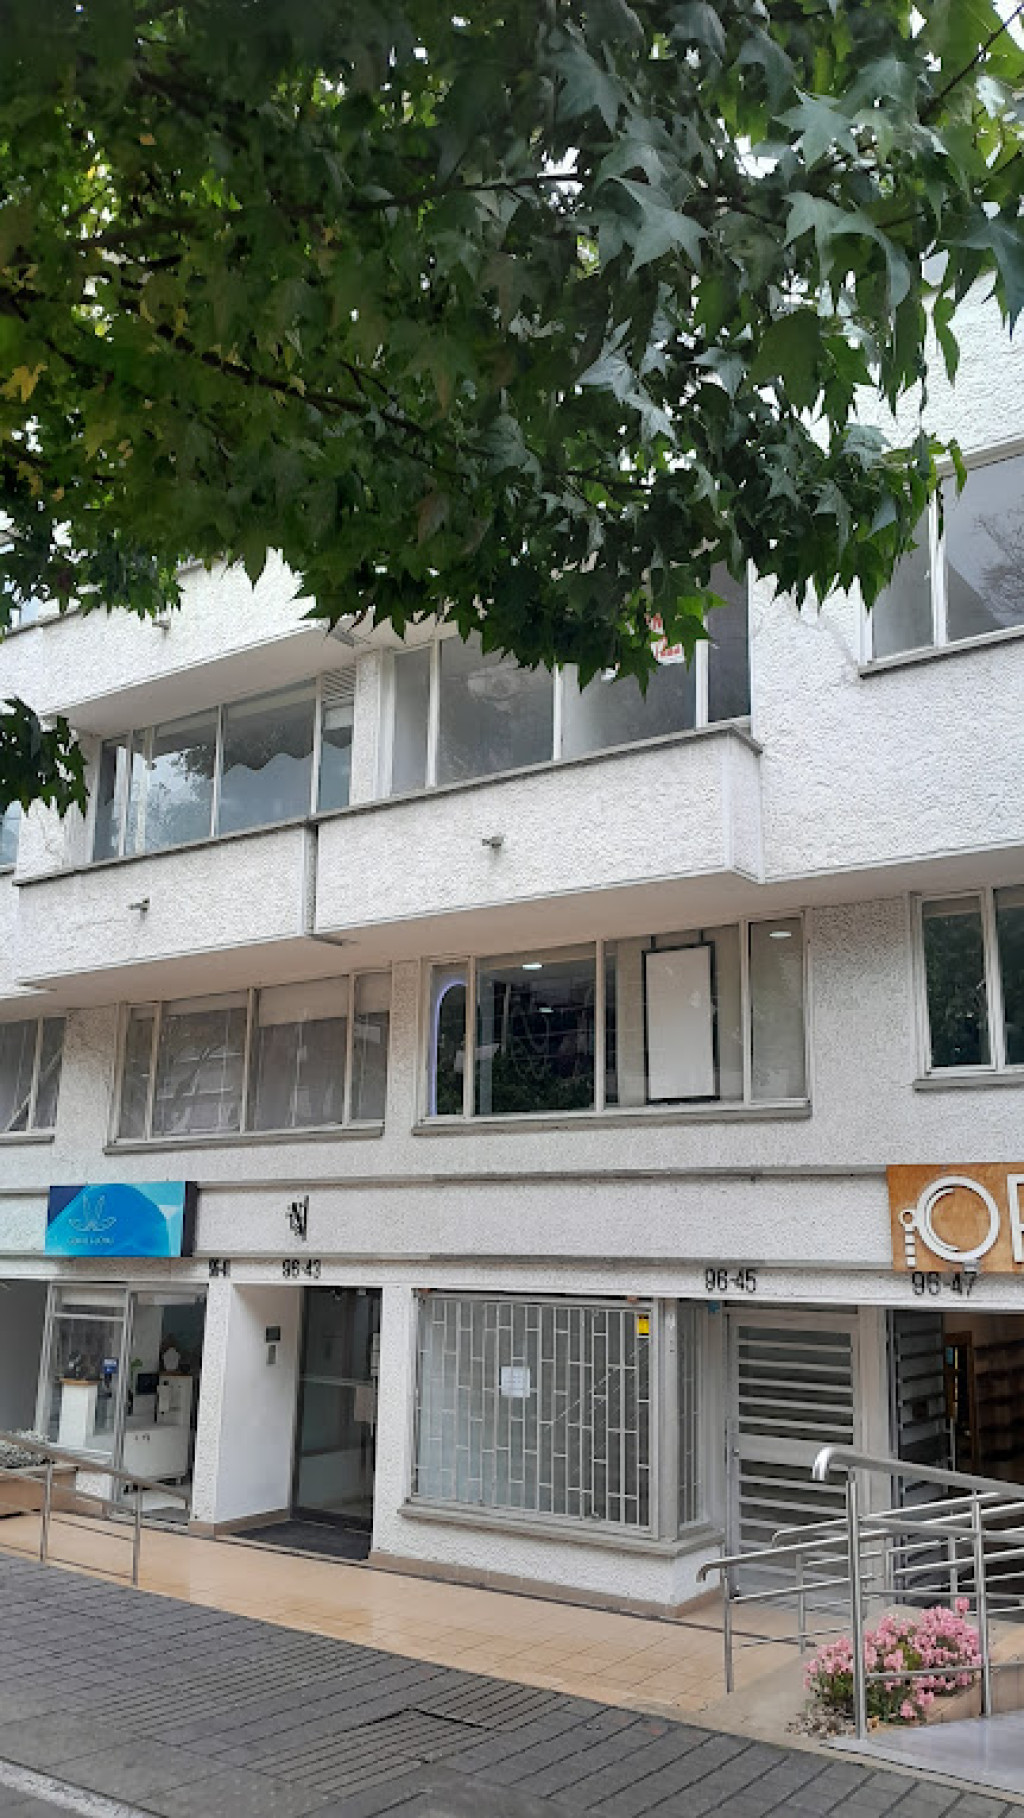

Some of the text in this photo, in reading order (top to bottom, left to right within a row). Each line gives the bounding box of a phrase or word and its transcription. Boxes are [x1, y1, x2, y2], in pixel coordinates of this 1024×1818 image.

[282, 1258, 321, 1280] 96-43
[705, 1268, 757, 1294] 96-45
[912, 1271, 978, 1297] 96-47
